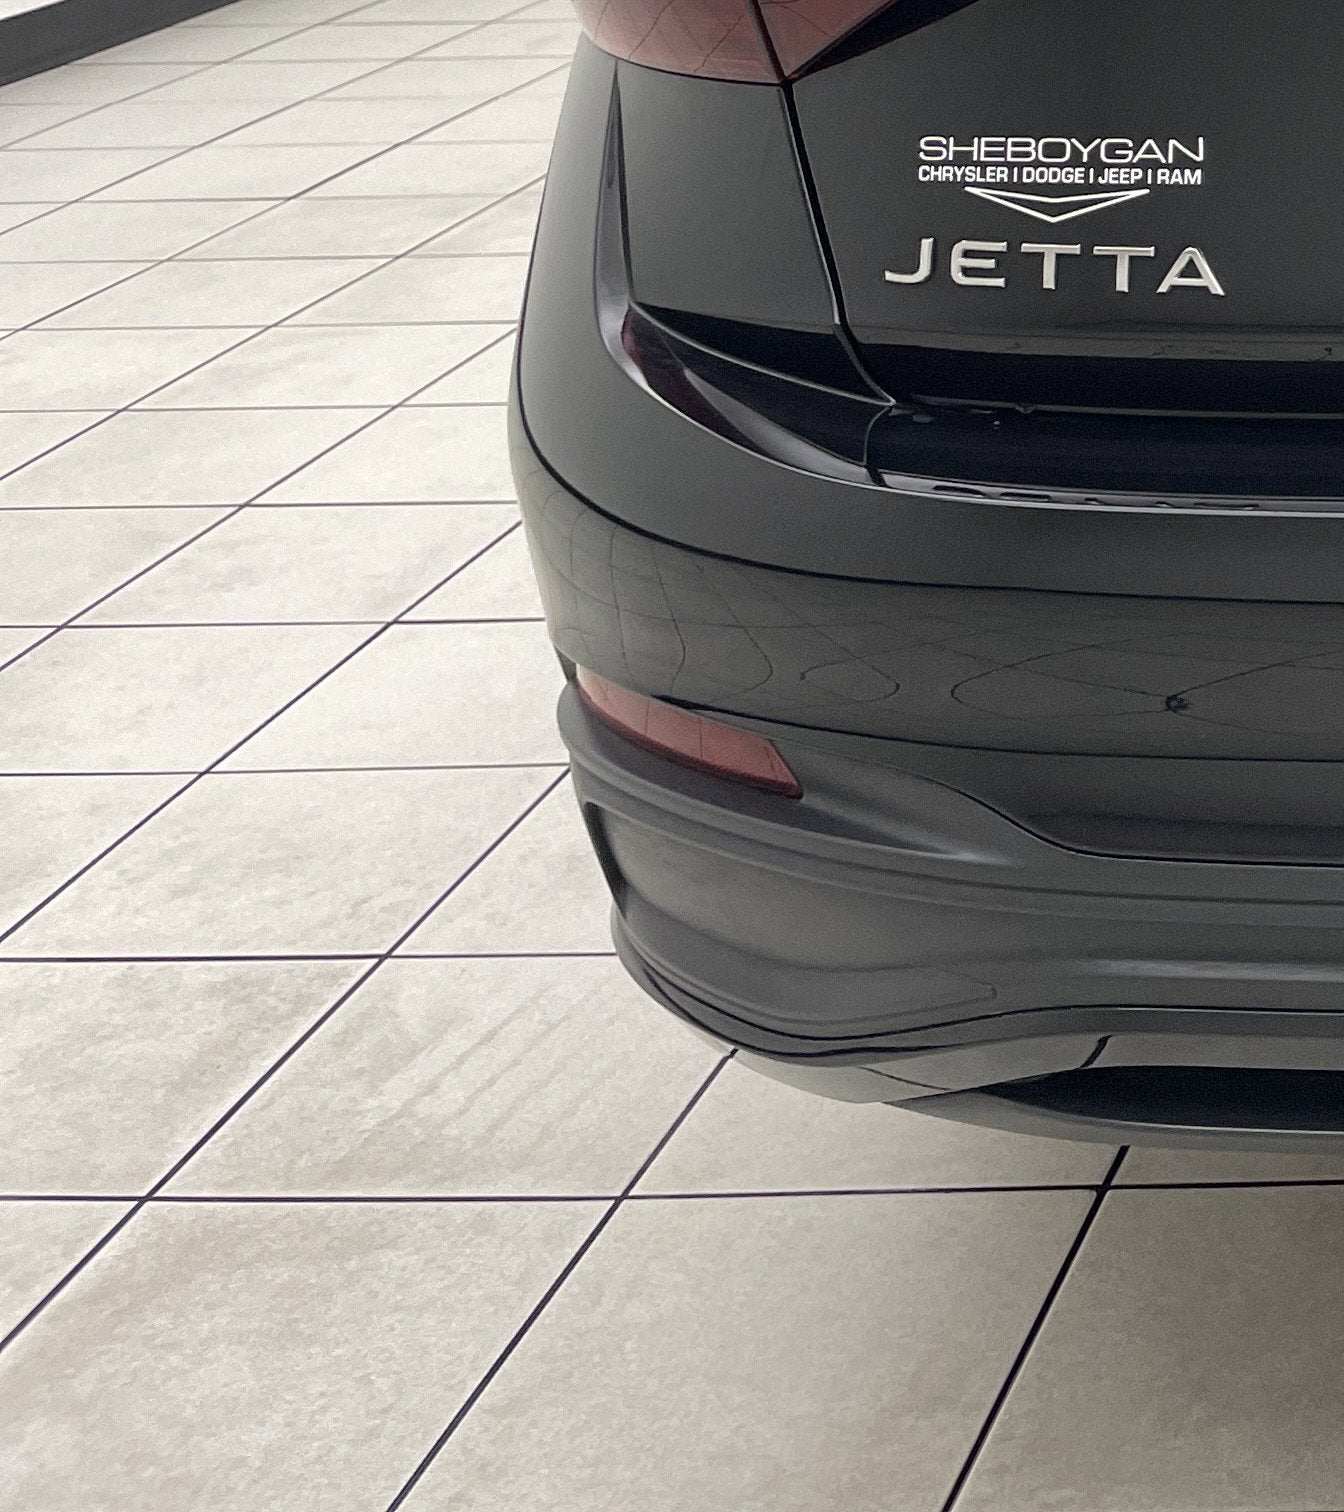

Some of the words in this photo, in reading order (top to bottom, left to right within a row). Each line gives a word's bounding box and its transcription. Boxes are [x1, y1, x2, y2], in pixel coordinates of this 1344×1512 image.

[918, 136, 1204, 163] SHEBOYGAN
[918, 166, 1009, 184] CHRYSLER
[1022, 168, 1085, 185] DODGE
[1098, 168, 1143, 186] JEEP
[1156, 169, 1202, 186] RAM
[884, 237, 1226, 297] JETTA
